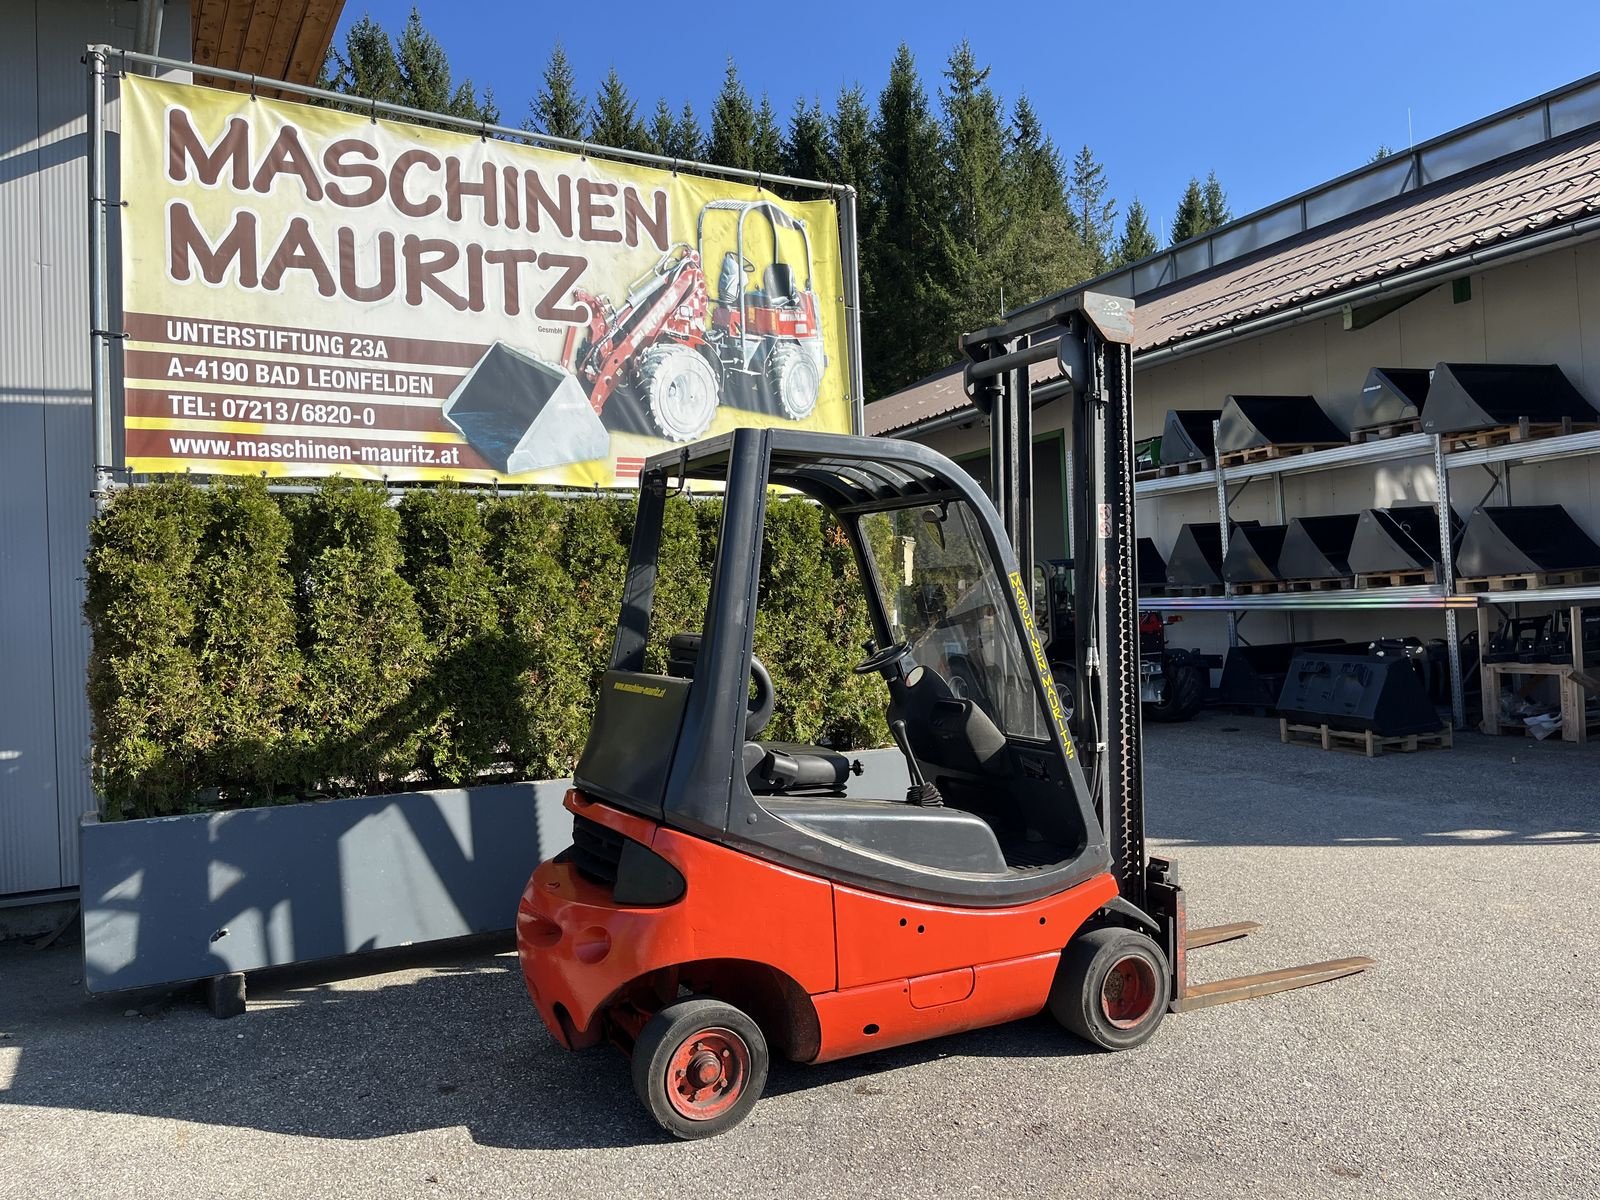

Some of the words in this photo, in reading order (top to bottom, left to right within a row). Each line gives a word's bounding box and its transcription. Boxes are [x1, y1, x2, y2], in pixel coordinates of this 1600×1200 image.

[168, 107, 668, 251] MASCHINEN
[169, 201, 590, 323] MAURITZ
[167, 320, 344, 356] UNTERSTIFTUNG
[350, 337, 389, 359] 23A
[537, 325, 563, 334] GesmbH
[167, 357, 249, 383] A-4190
[255, 363, 300, 386] BAD
[307, 368, 434, 395] LEONFELDEN
[168, 395, 217, 418] TEL:
[222, 399, 376, 426] 07213/6820-0
[169, 437, 460, 466] www.maschinen-mauritz.at
[1010, 573, 1047, 673] MASCHINEN
[1042, 674, 1074, 755] MAURITZ
